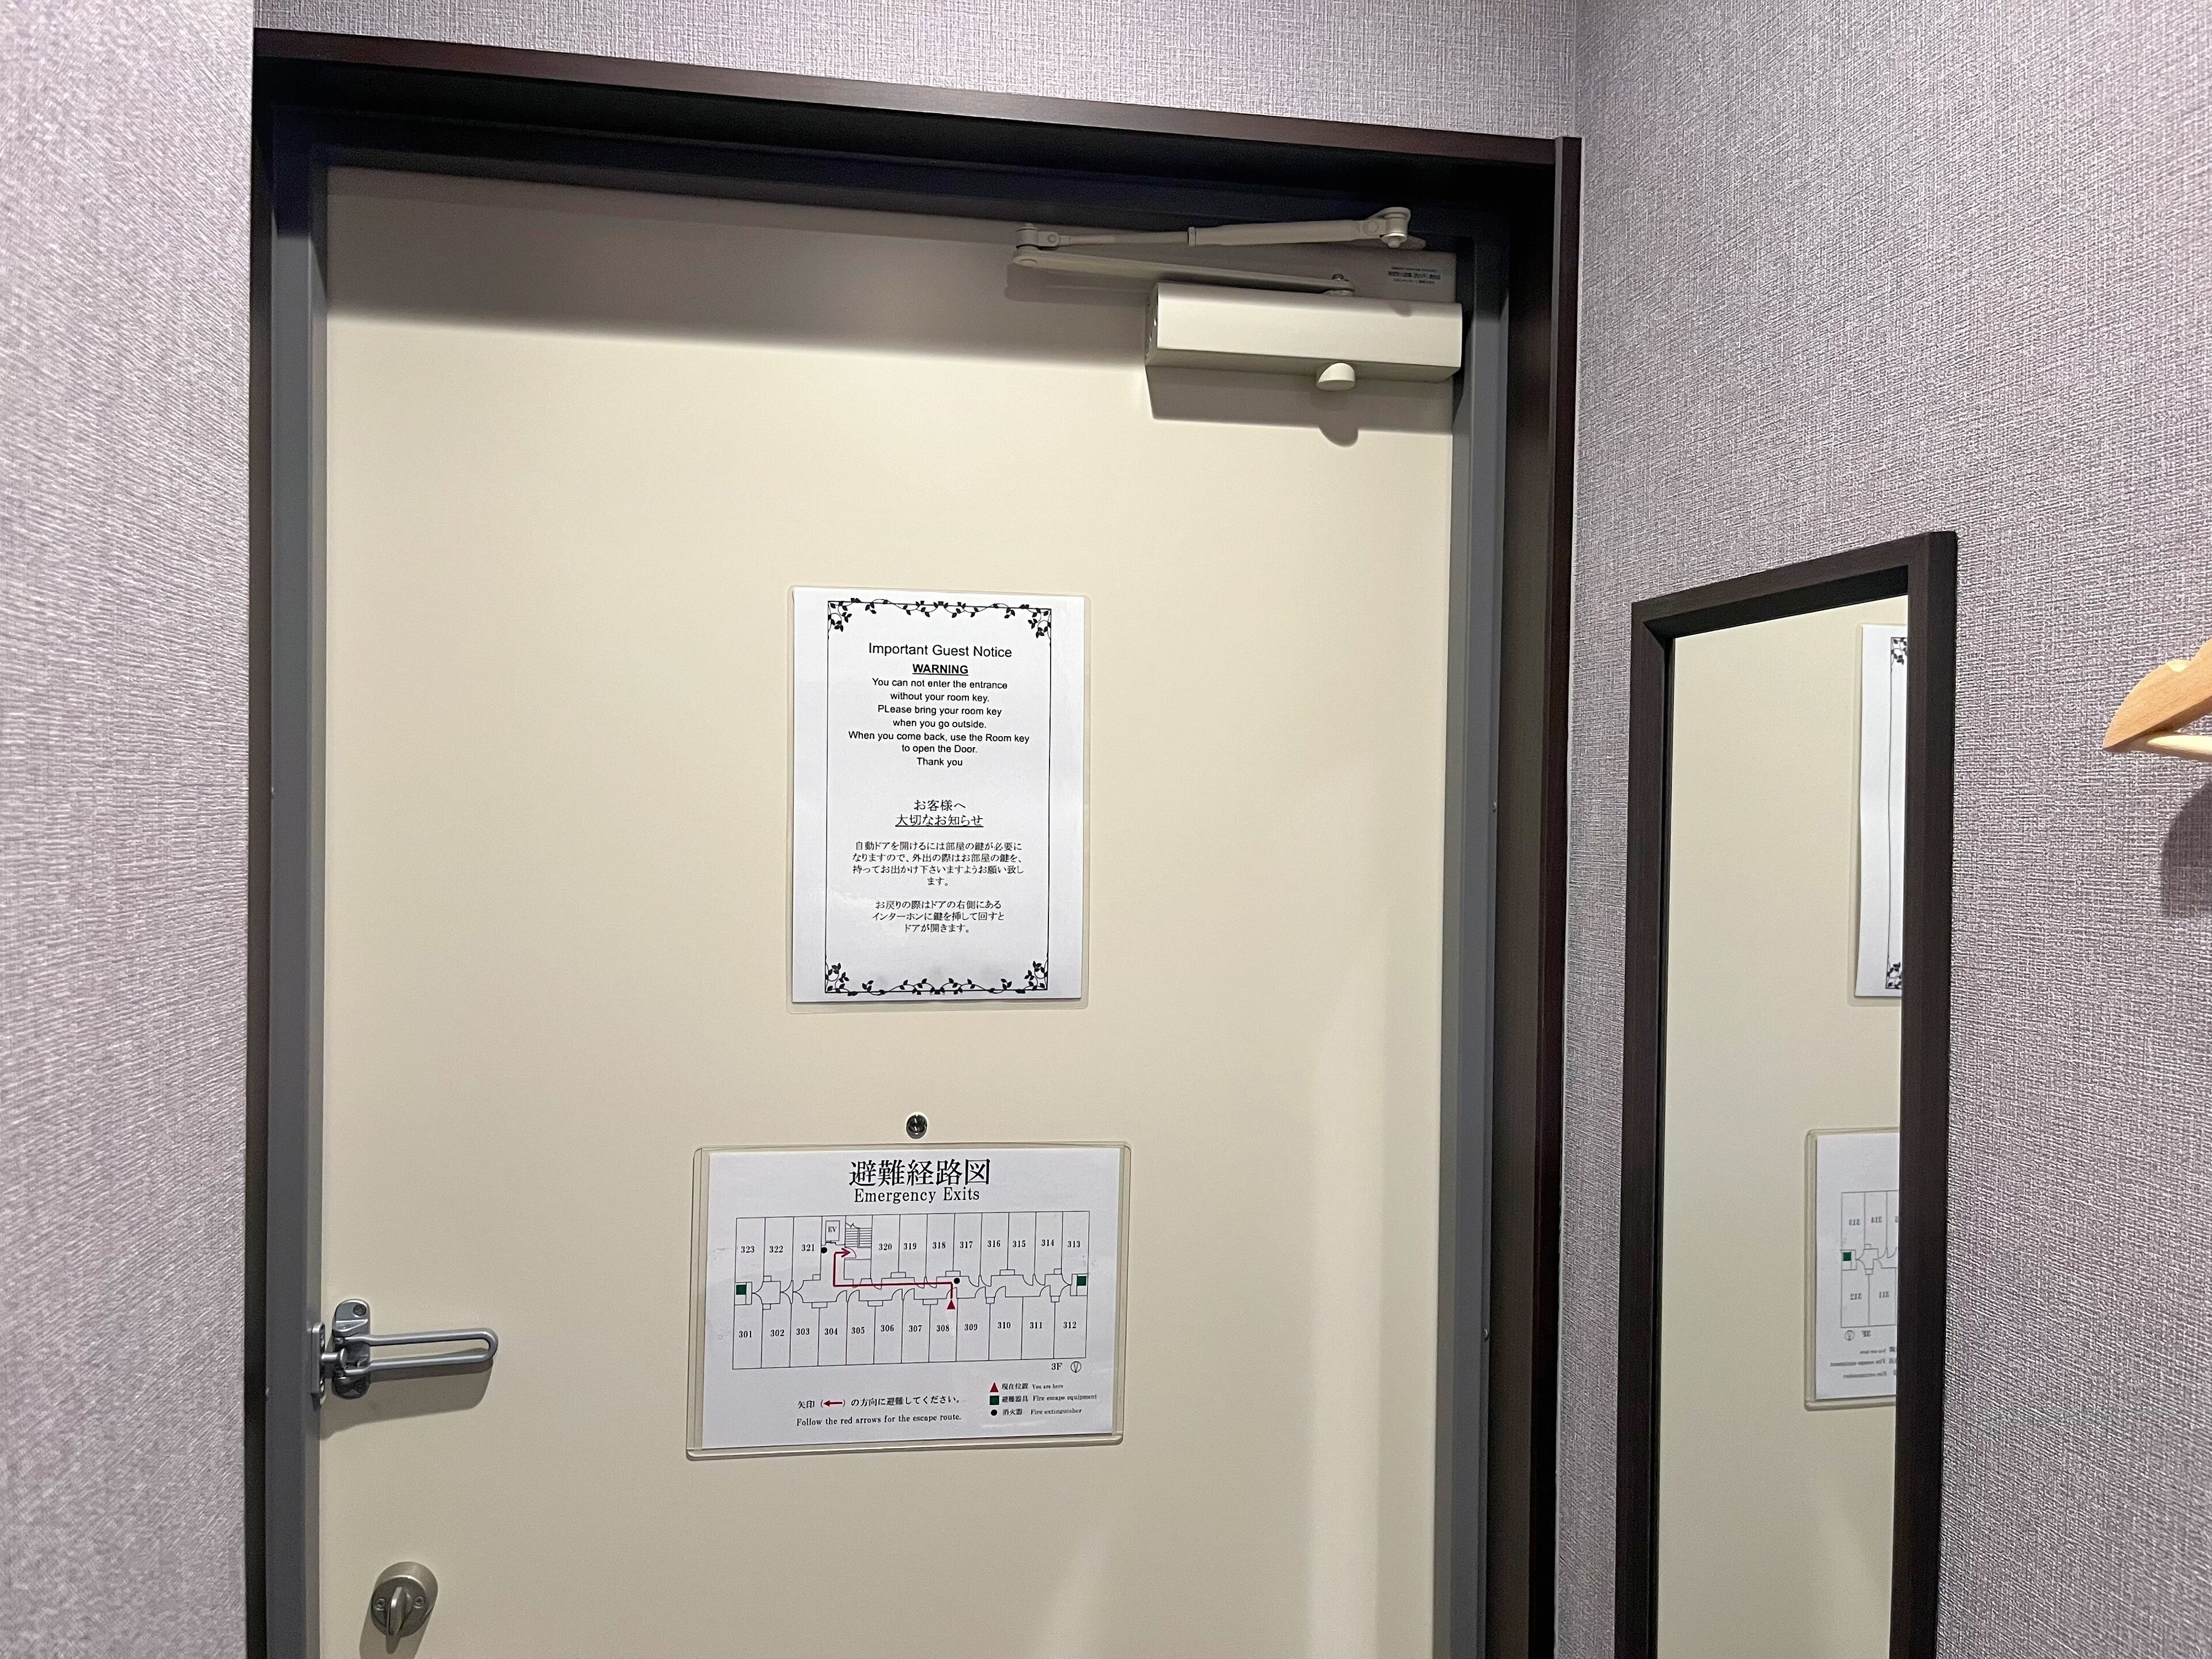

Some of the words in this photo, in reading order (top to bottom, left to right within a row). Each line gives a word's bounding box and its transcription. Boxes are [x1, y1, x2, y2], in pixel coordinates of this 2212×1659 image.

[869, 643, 927, 656] Important
[933, 645, 969, 656] Guest
[974, 646, 1012, 657] Notice
[912, 664, 968, 676] WARNING
[891, 692, 922, 700] without
[972, 694, 989, 703] key.
[878, 705, 911, 713] PLease
[915, 706, 936, 715] bring
[987, 707, 1002, 717] key
[920, 721, 935, 729] you
[938, 721, 949, 729] go
[849, 731, 874, 739] When
[878, 733, 893, 741] you
[925, 733, 947, 741] back,
[1014, 734, 1029, 744] key
[955, 745, 977, 753] Door.
[916, 757, 944, 766] Thank
[914, 800, 965, 811] お客様へ
[895, 814, 984, 827] 大切なお知らせ
[856, 841, 1022, 851] 自動ドアを開けるには部屋の鍵が必要に
[853, 853, 1021, 862] なりますので、外出の際はお部屋の鍵を、
[853, 865, 1024, 874] 持ってお出かけ下さいますようお願い致し
[927, 877, 948, 886] ます。
[876, 900, 1001, 909] お戻りの際はドアの右側にある
[872, 912, 1004, 921] インターホンに鍵を挿して回すと
[906, 923, 968, 933] ドアが開きます。
[849, 1158, 990, 1187] 避難経路図
[854, 1188, 936, 1204] Emergency
[944, 1187, 979, 1200] Exits
